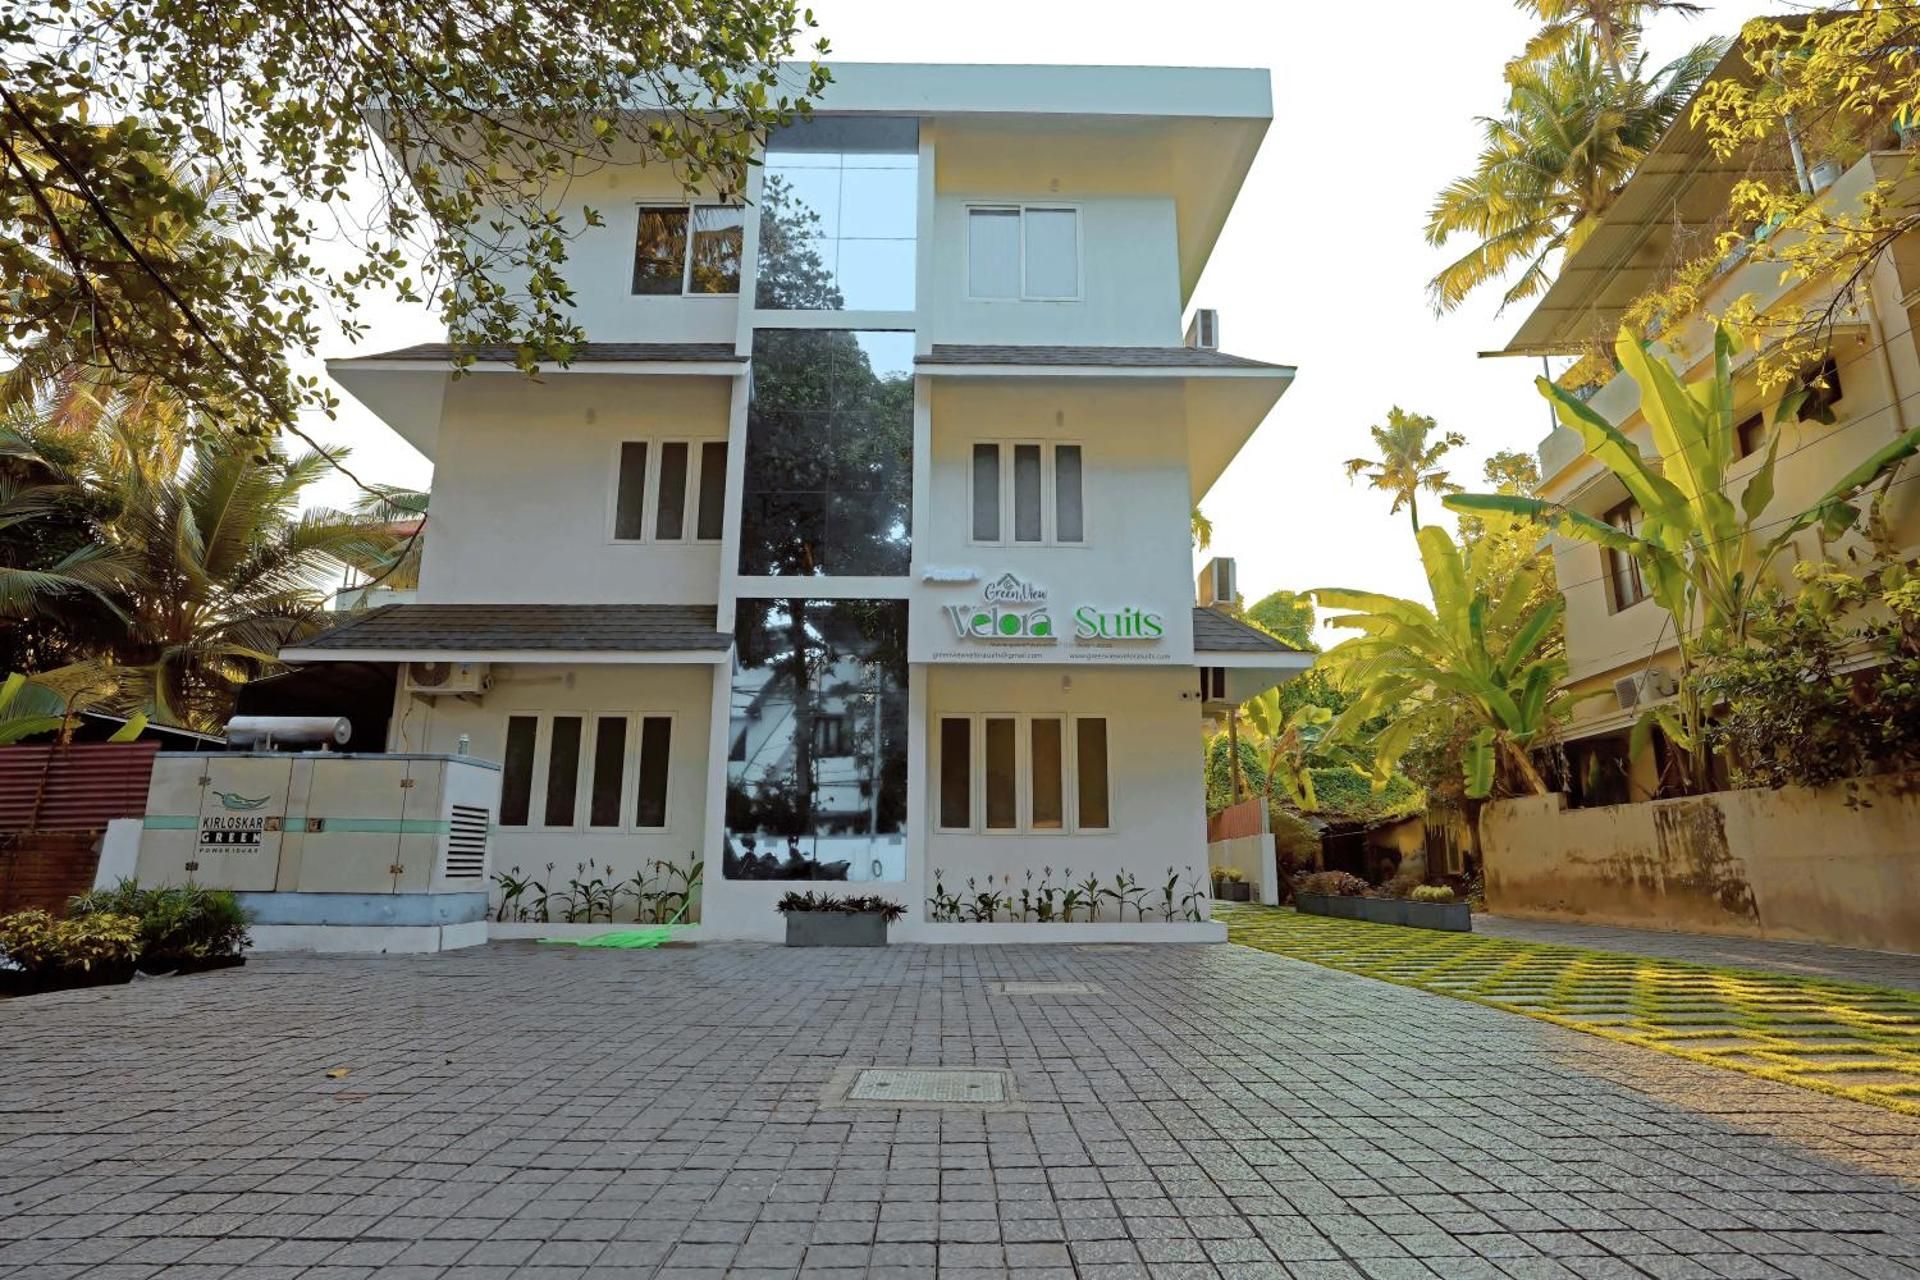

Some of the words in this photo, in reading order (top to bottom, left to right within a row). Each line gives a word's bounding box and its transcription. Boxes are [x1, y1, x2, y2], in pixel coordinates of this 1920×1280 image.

[984, 583, 1018, 600] Green
[1020, 583, 1048, 600] View
[1076, 606, 1162, 637] Suits
[203, 816, 263, 829] KIRLOSKAR
[201, 832, 261, 843] GREEN
